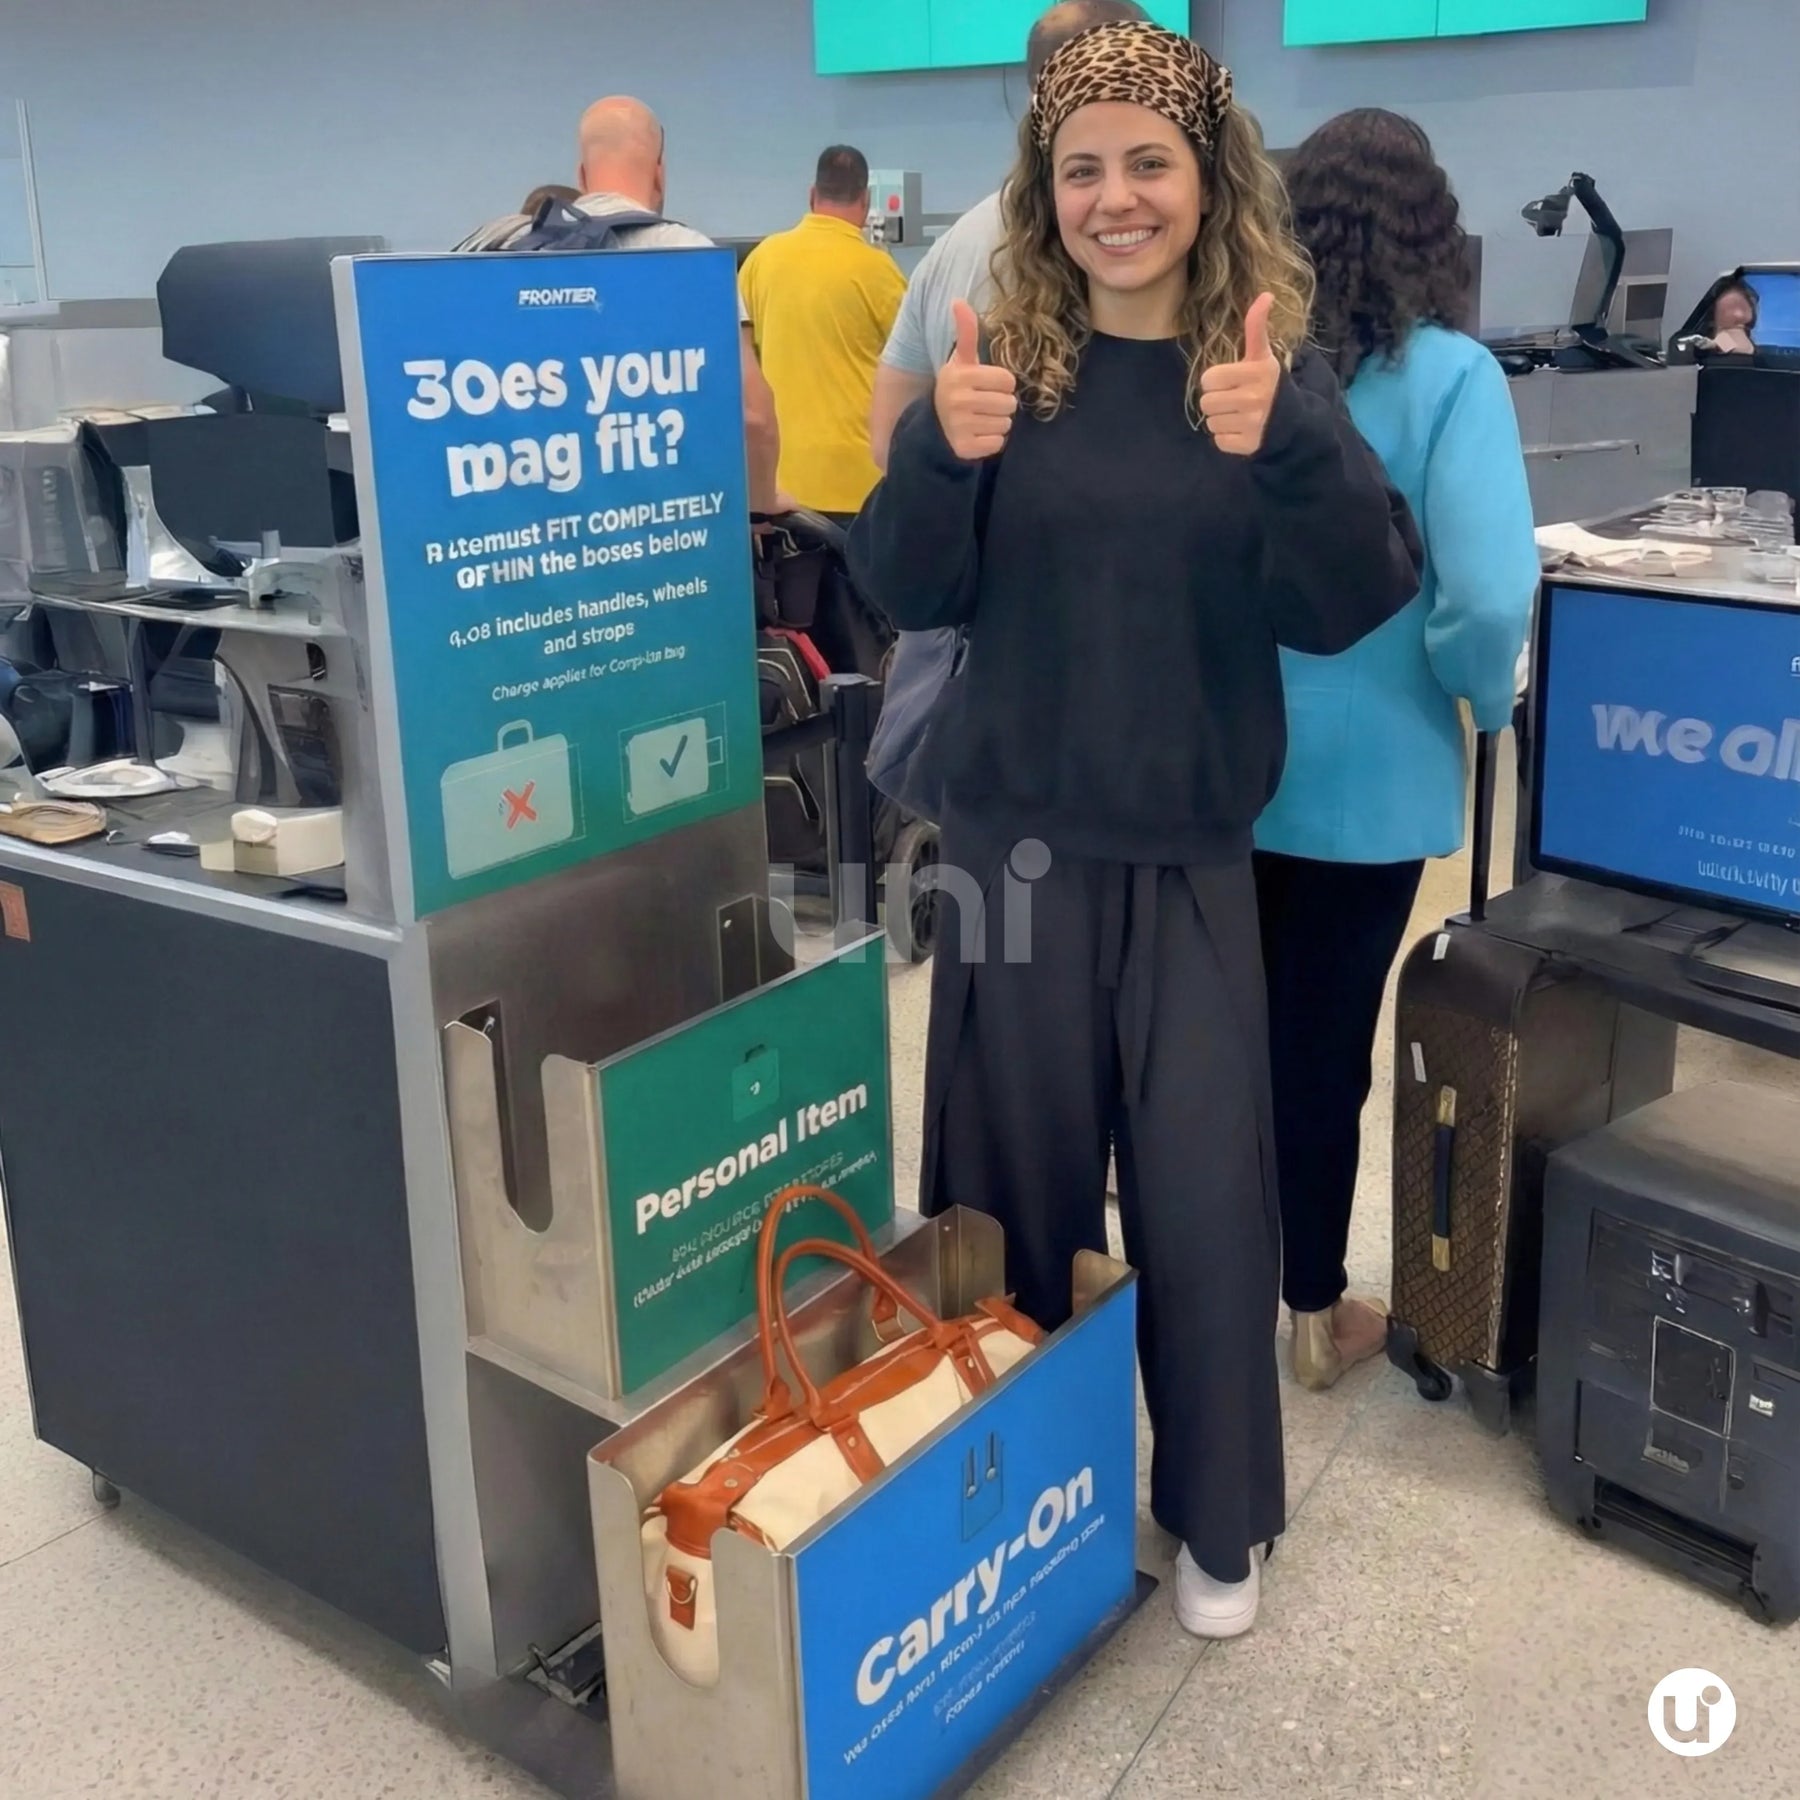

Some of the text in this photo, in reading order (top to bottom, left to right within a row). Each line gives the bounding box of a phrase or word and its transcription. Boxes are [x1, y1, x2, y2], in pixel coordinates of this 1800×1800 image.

[518, 287, 597, 306] FRONTIER
[581, 347, 706, 415] your
[595, 408, 685, 474] fit?
[546, 514, 582, 543] FIT
[588, 491, 725, 535] COMPLETELY
[540, 549, 577, 576] the
[649, 528, 709, 556] below
[496, 606, 574, 637] includes
[578, 591, 649, 620] handles,
[653, 576, 709, 604] wheels
[543, 630, 577, 656] and
[636, 1118, 788, 1236] Personal
[796, 1082, 868, 1144] Item
[856, 1466, 1095, 1707] Carry-On
